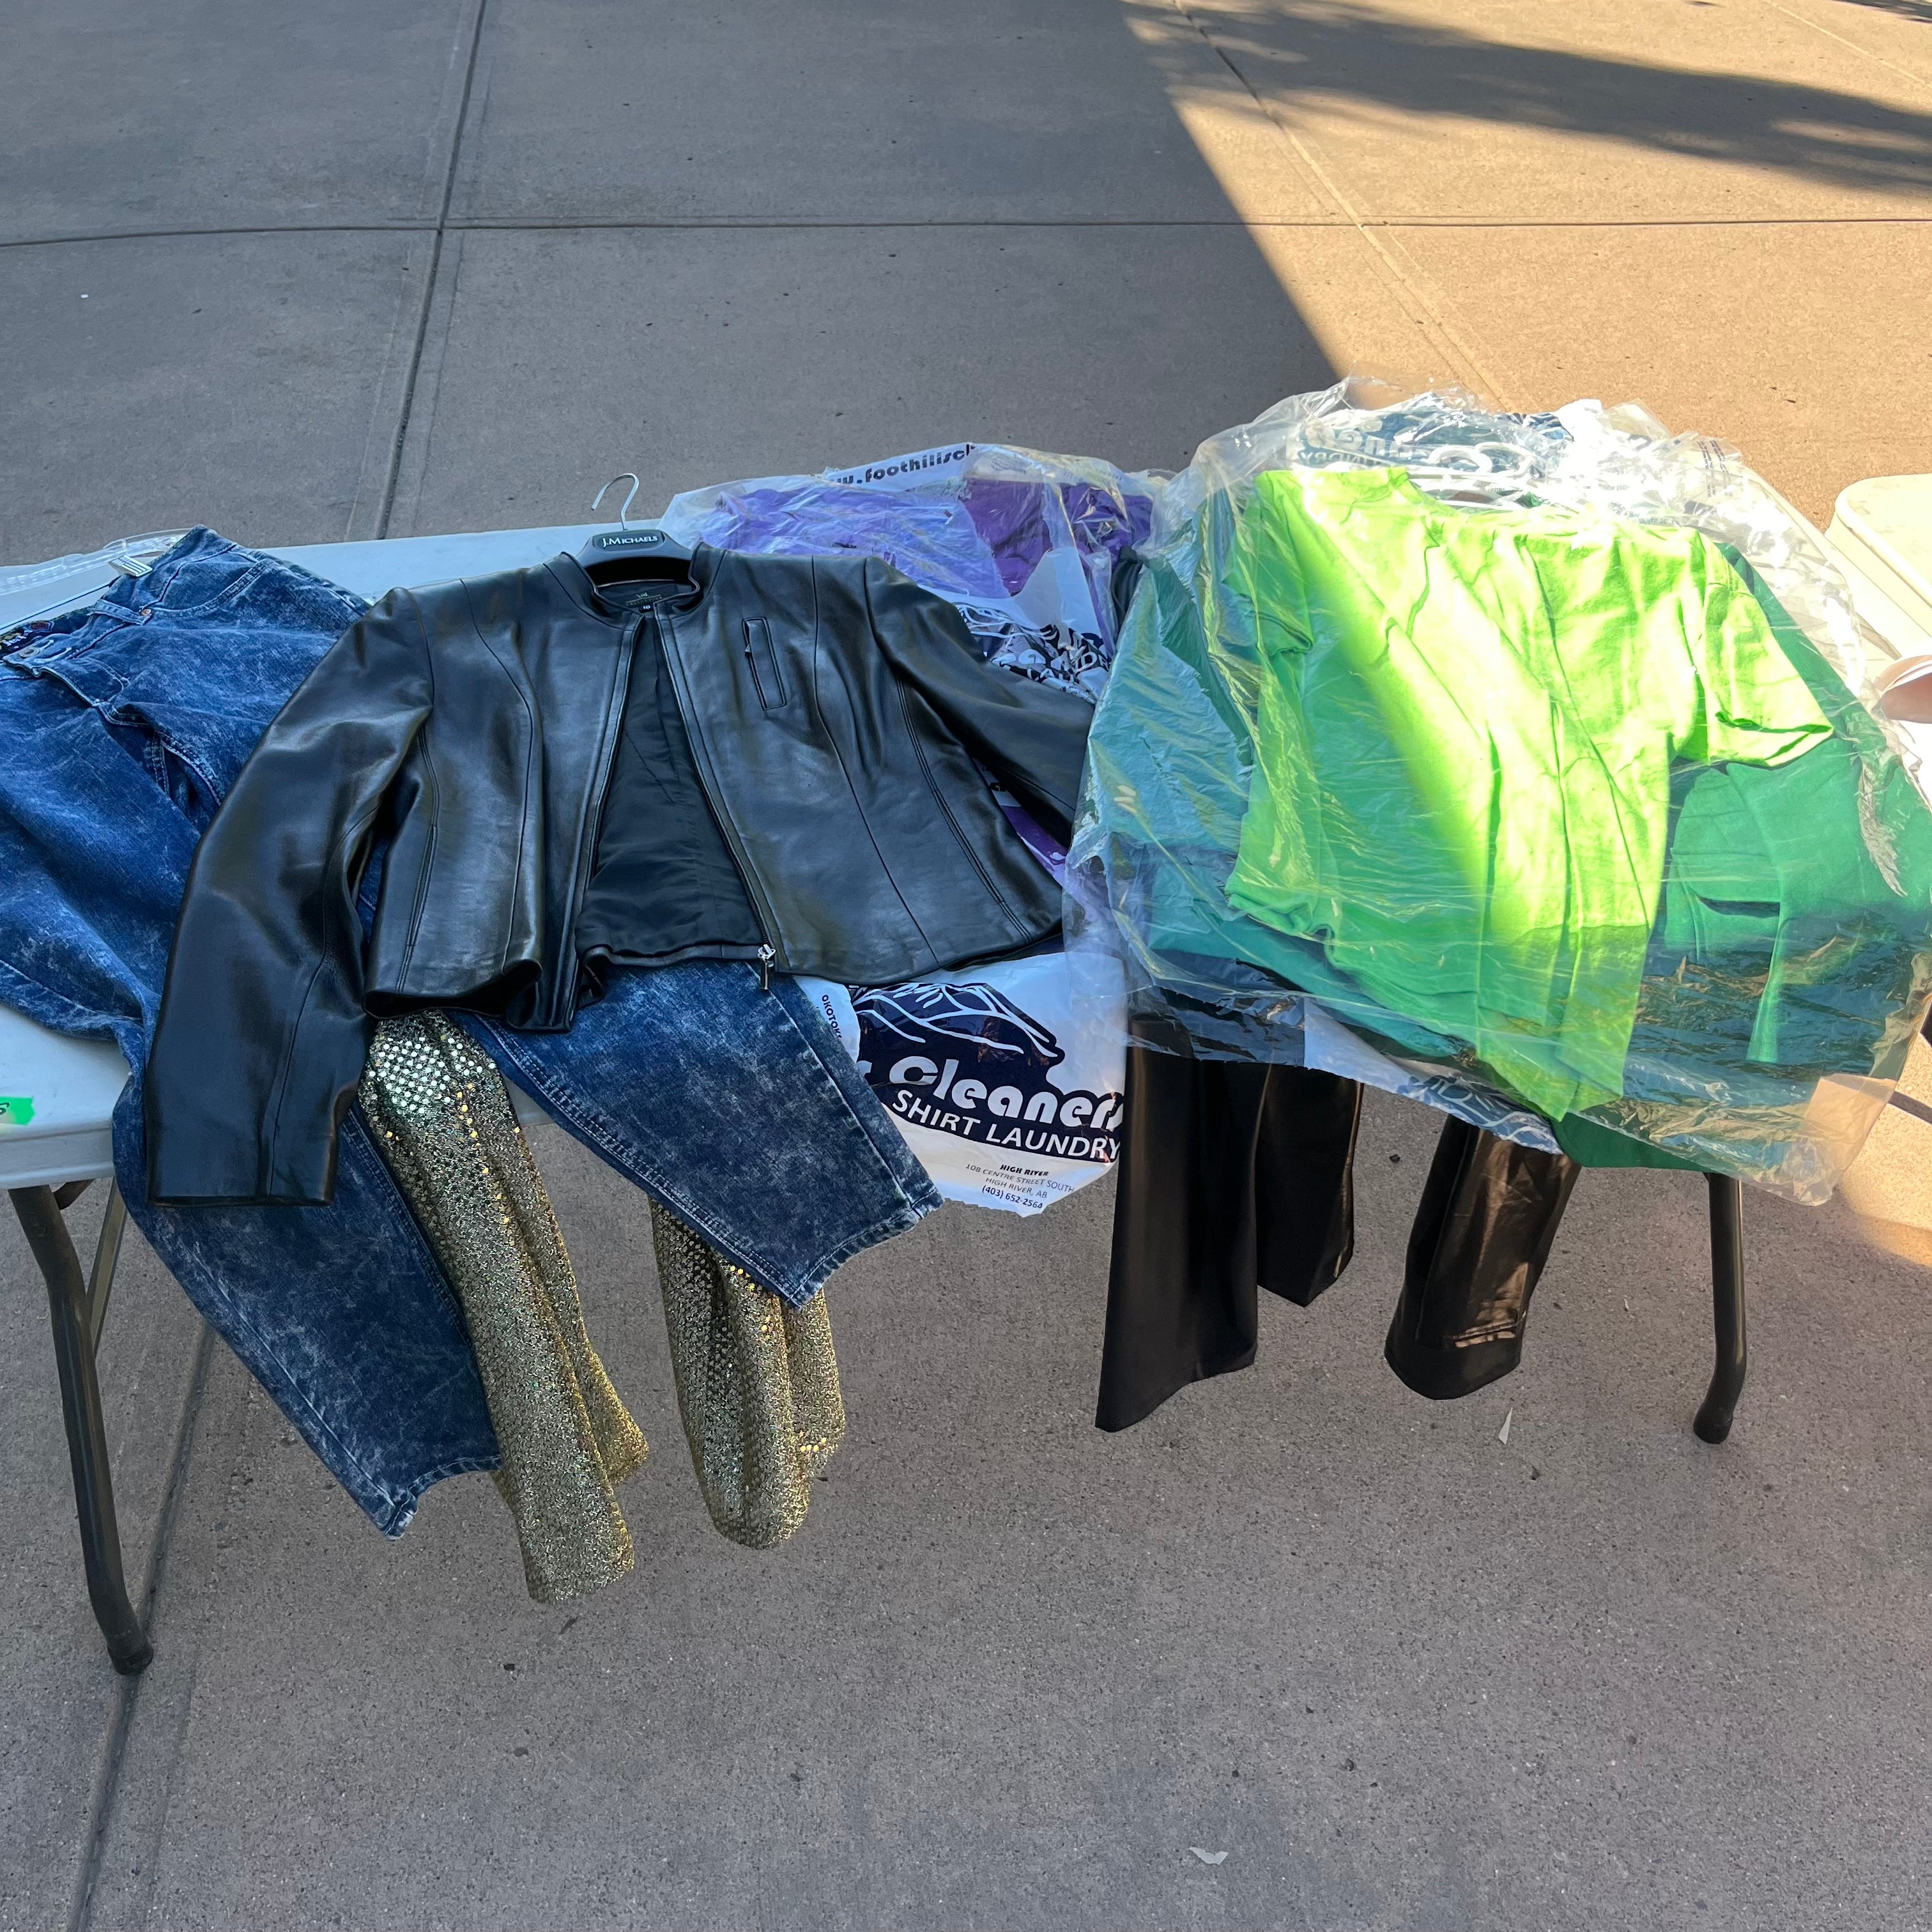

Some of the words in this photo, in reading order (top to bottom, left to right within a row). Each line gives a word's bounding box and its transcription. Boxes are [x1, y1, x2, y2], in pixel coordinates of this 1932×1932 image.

[822, 994, 842, 1038] OKOTOK
[892, 1089, 981, 1136] SHIRT
[986, 1123, 1121, 1160] LAUNDRY
[965, 1163, 981, 1172] 108
[983, 1169, 1017, 1181] CENTRE
[1016, 1177, 1046, 1185] STREET
[1046, 1180, 1075, 1192] SOUTH
[999, 1164, 1023, 1175] HIGH
[982, 1184, 1004, 1199] (403)
[1005, 1192, 1043, 1209] 652-2564
[985, 1177, 1008, 1187] HIGH
[1008, 1184, 1033, 1196] RIVER,
[1036, 1190, 1048, 1199] AB
